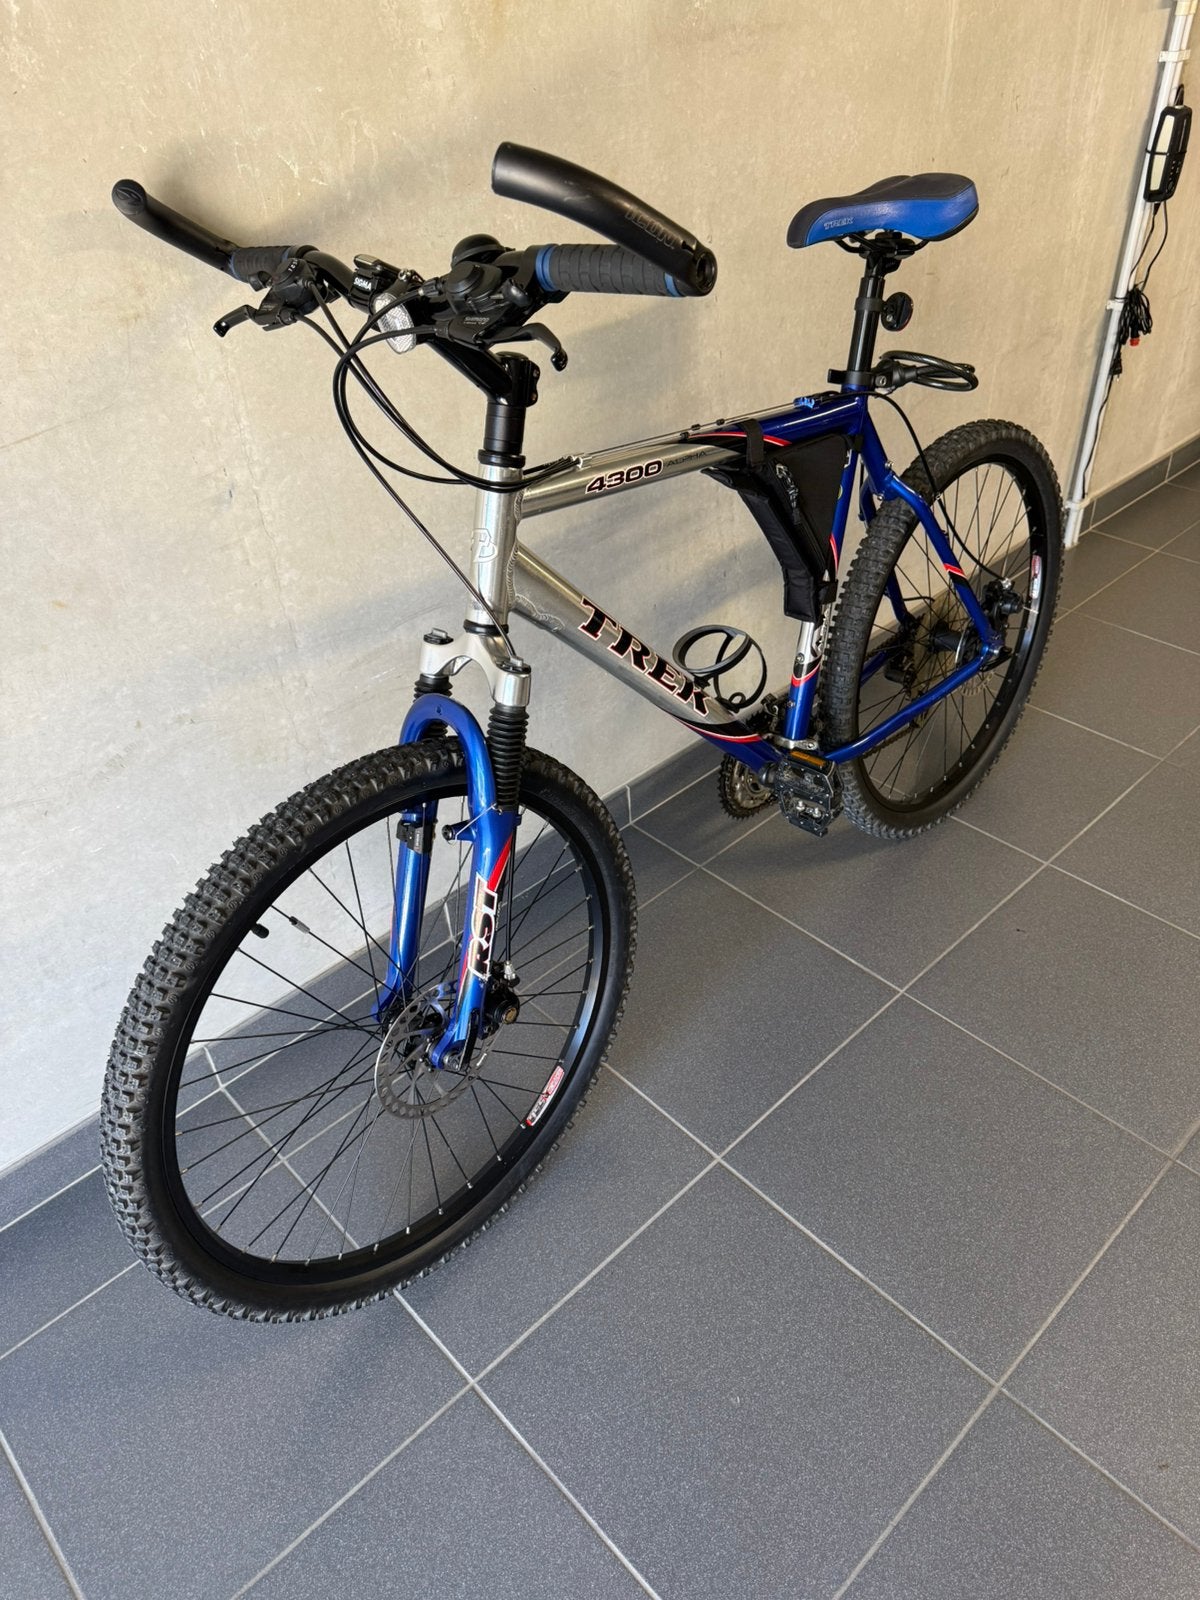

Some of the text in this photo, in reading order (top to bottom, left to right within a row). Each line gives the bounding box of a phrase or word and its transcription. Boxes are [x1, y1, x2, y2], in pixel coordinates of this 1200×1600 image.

[353, 276, 372, 291] SIGMA
[585, 459, 663, 495] 4300
[578, 595, 710, 717] TREK
[468, 871, 498, 981] RST
